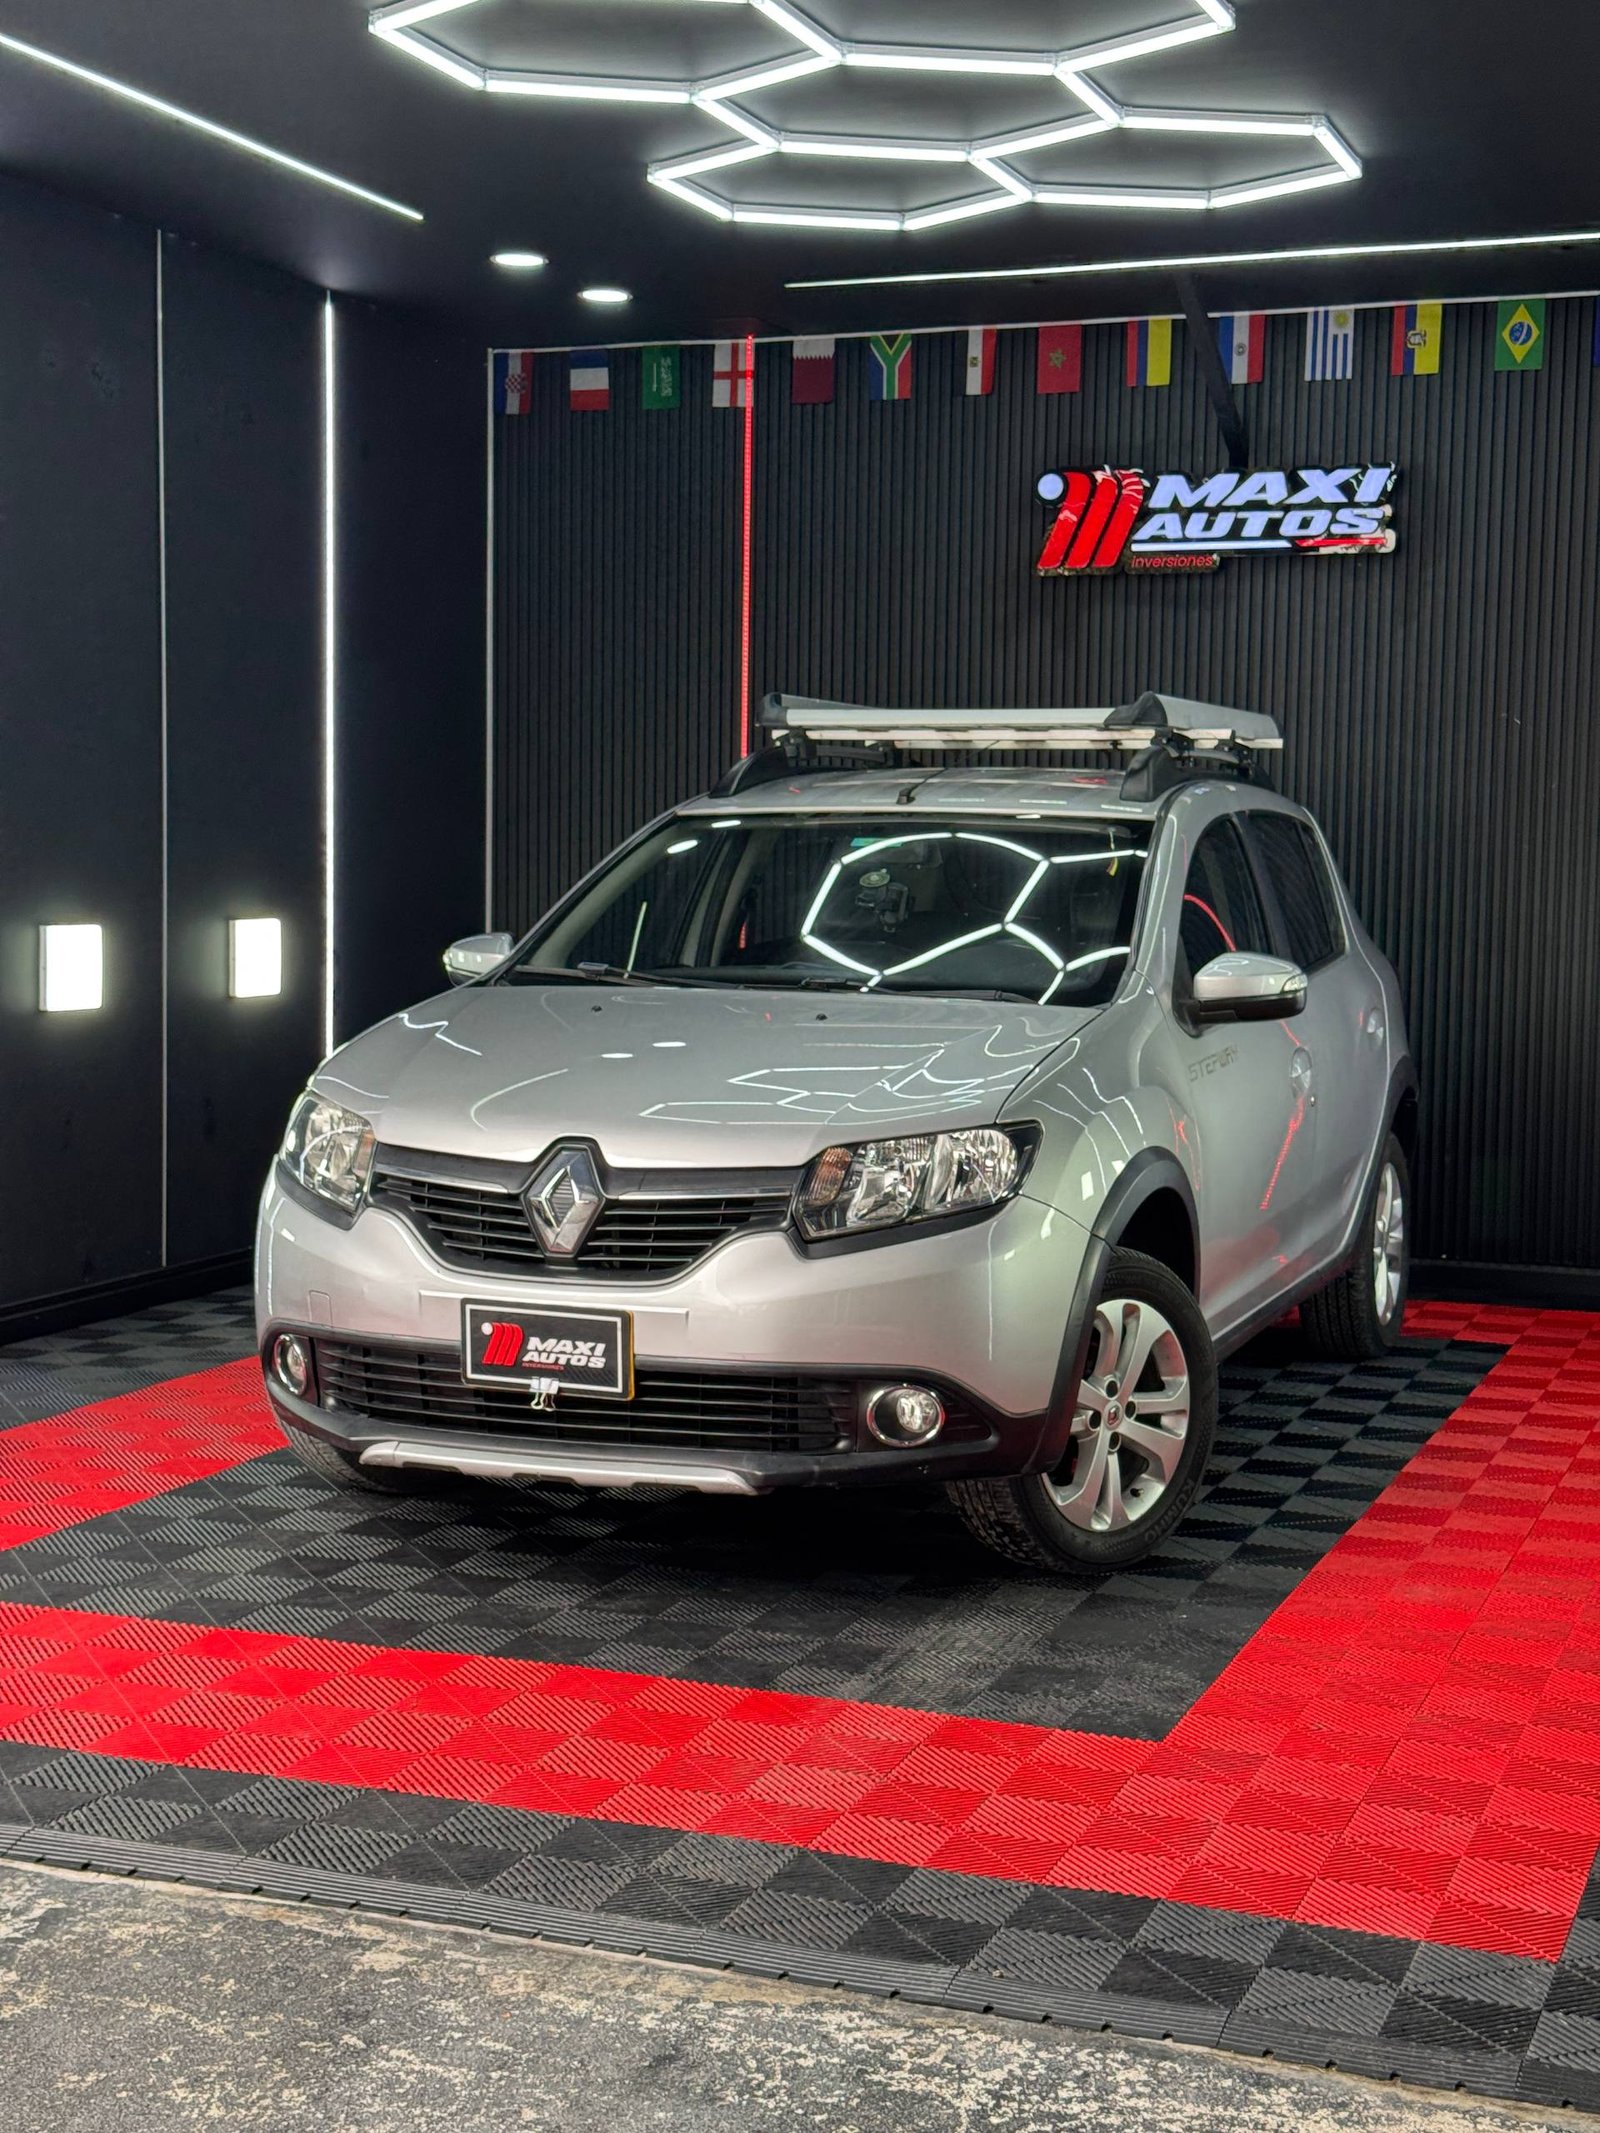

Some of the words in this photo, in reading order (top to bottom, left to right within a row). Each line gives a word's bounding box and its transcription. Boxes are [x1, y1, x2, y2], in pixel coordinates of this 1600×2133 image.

[1148, 467, 1393, 508] MAXI
[1131, 507, 1385, 540] AUTOS
[1131, 555, 1213, 569] inversiones
[526, 1336, 606, 1357] MAXI
[522, 1351, 606, 1369] AUTOS
